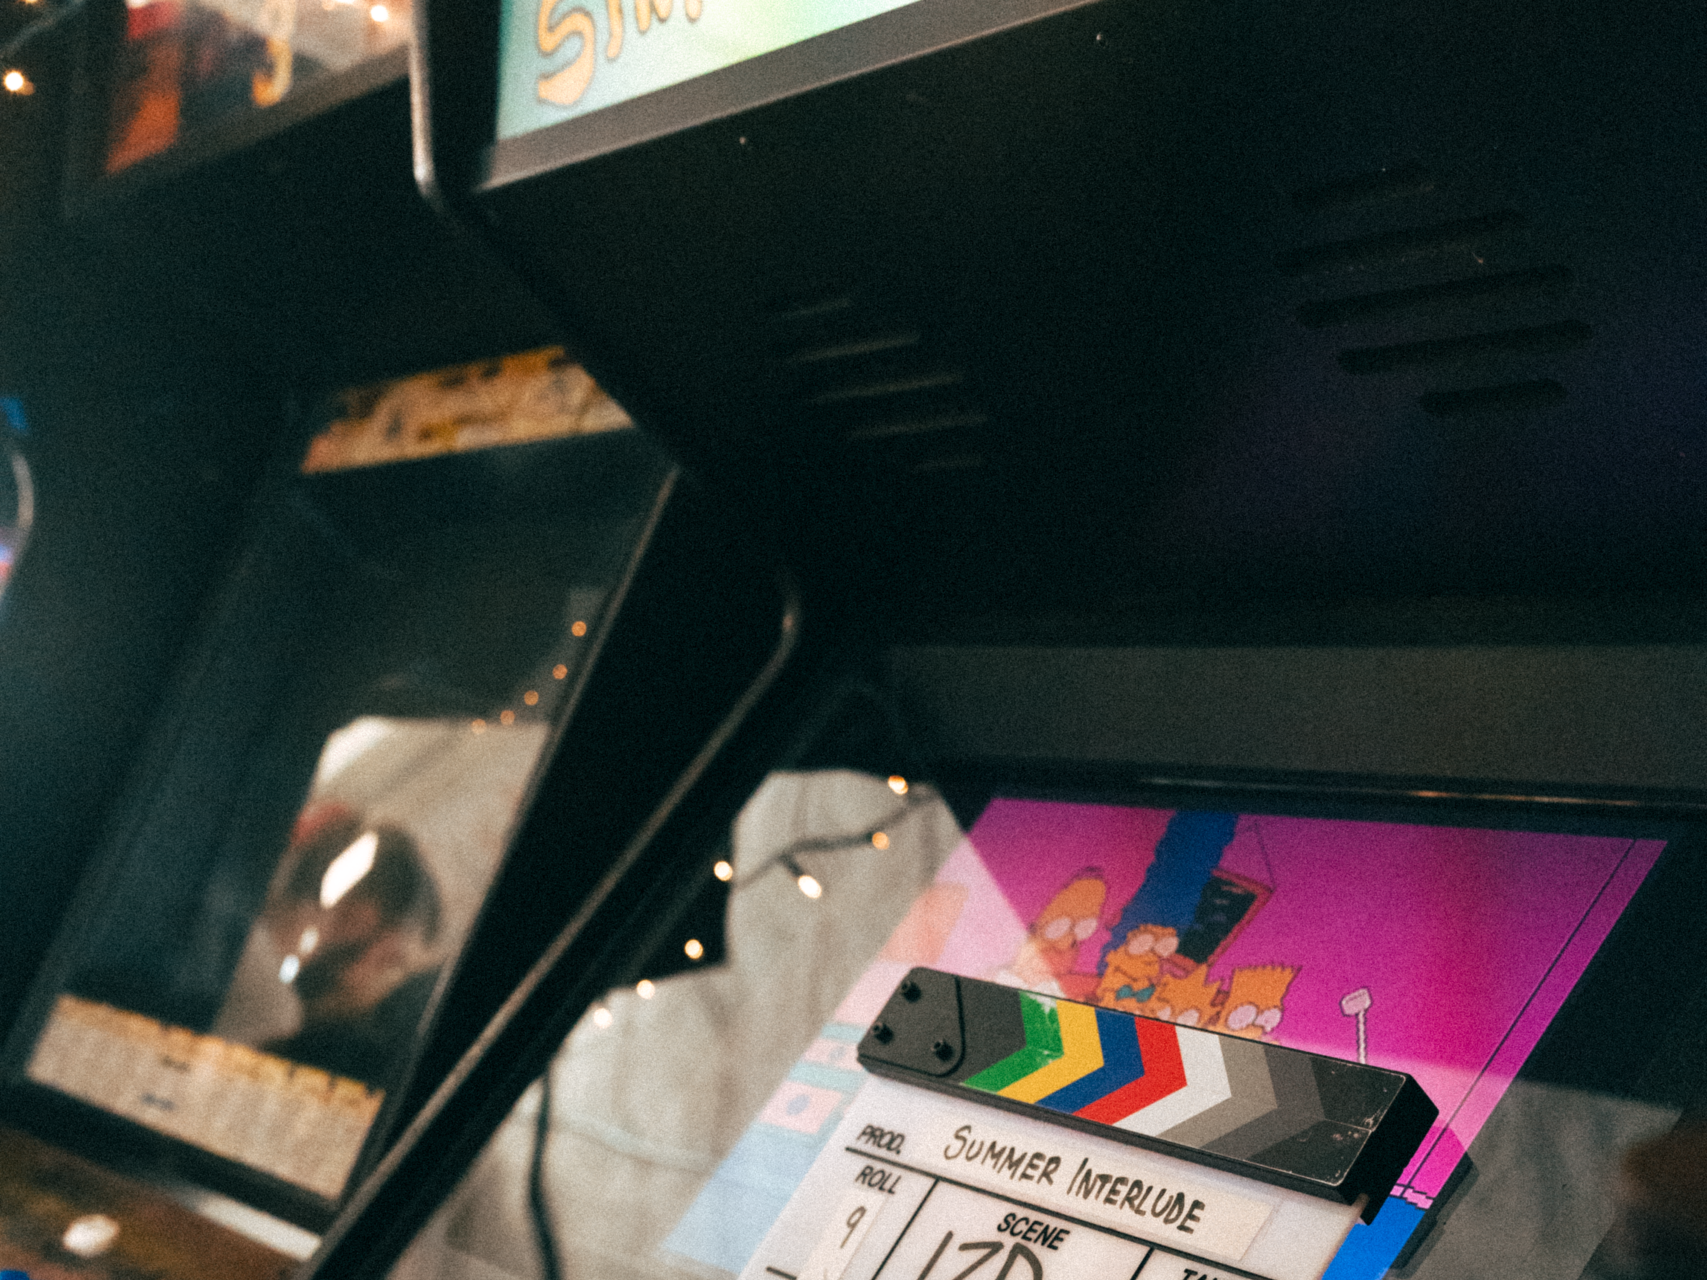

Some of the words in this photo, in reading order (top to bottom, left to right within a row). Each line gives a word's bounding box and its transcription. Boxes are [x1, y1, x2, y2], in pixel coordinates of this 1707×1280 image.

[856, 1123, 905, 1155] PROD.
[855, 1165, 902, 1194] ROLL
[944, 1124, 1062, 1186] SUMMER
[1066, 1157, 1206, 1235] INTERLUDE
[840, 1205, 867, 1250] 9
[996, 1212, 1071, 1251] SCENE
